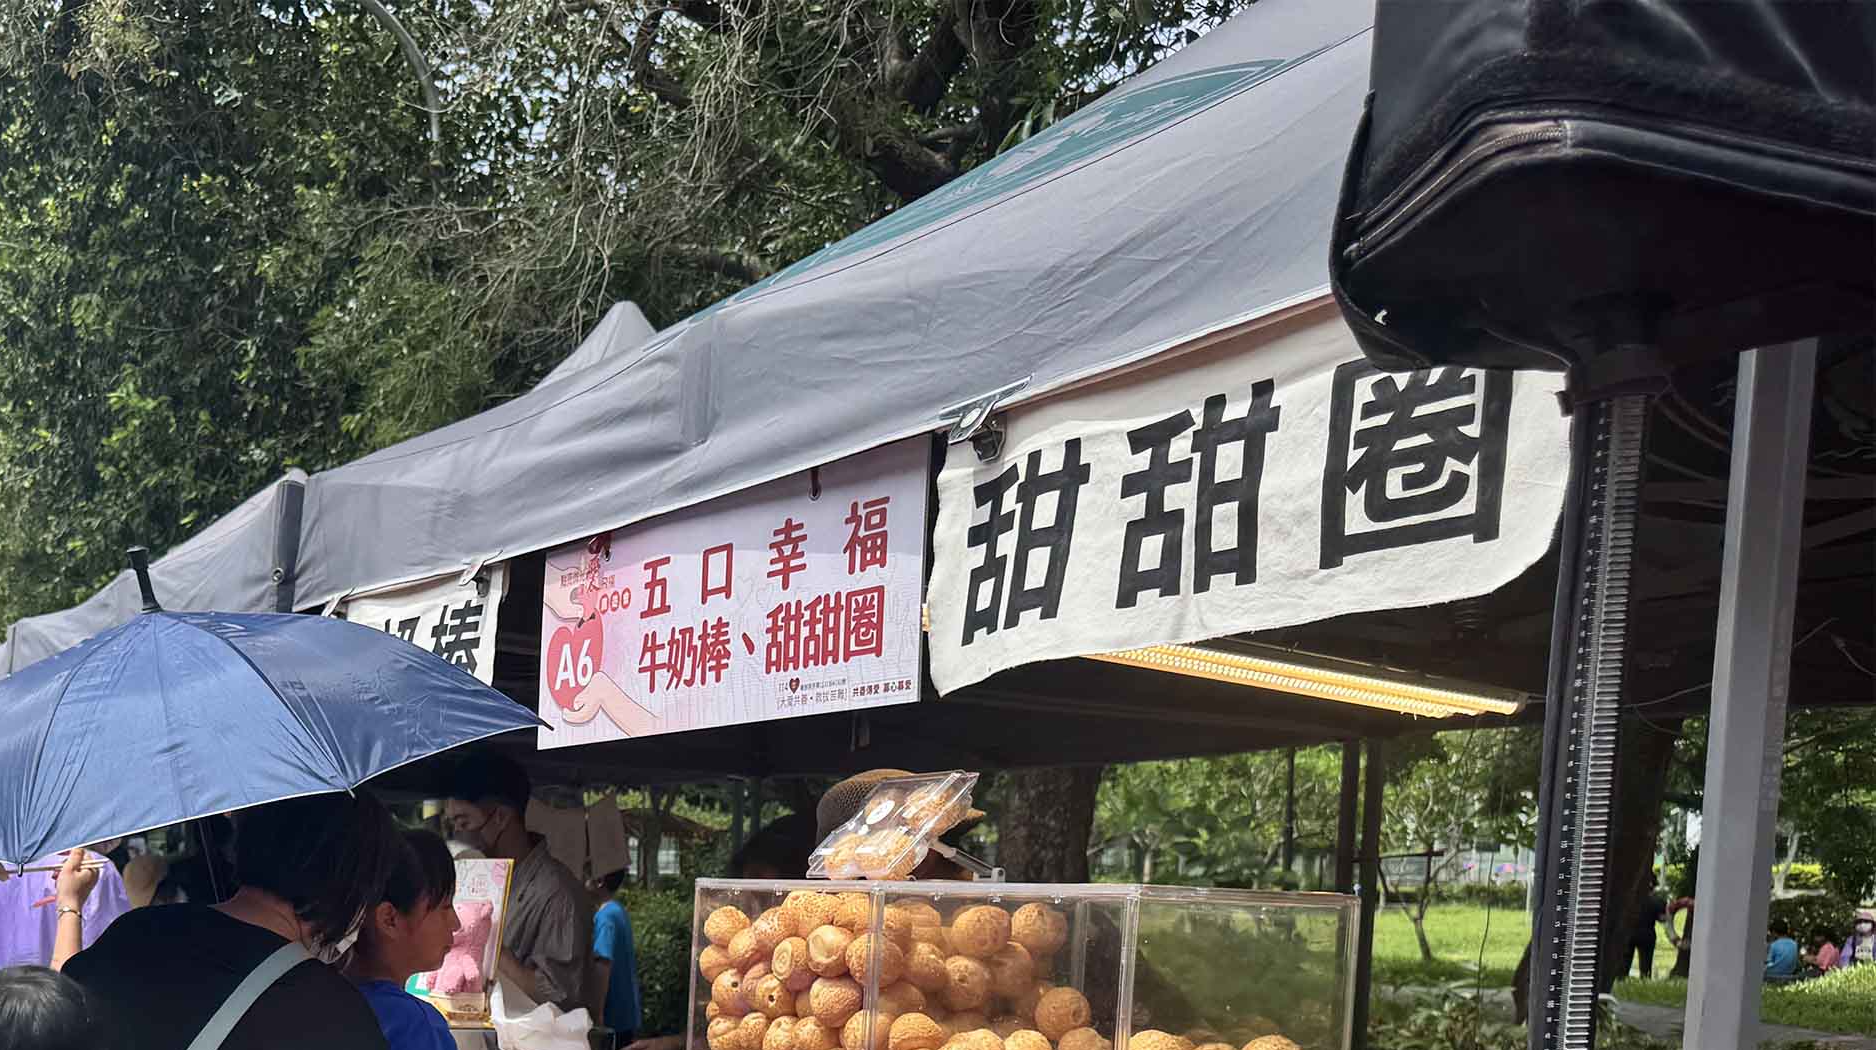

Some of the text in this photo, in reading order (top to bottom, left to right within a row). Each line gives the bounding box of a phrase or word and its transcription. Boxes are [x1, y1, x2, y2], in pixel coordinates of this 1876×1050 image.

[640, 496, 890, 619] 五口幸福
[961, 357, 1513, 647] 甜甜圈
[555, 640, 593, 690] A6
